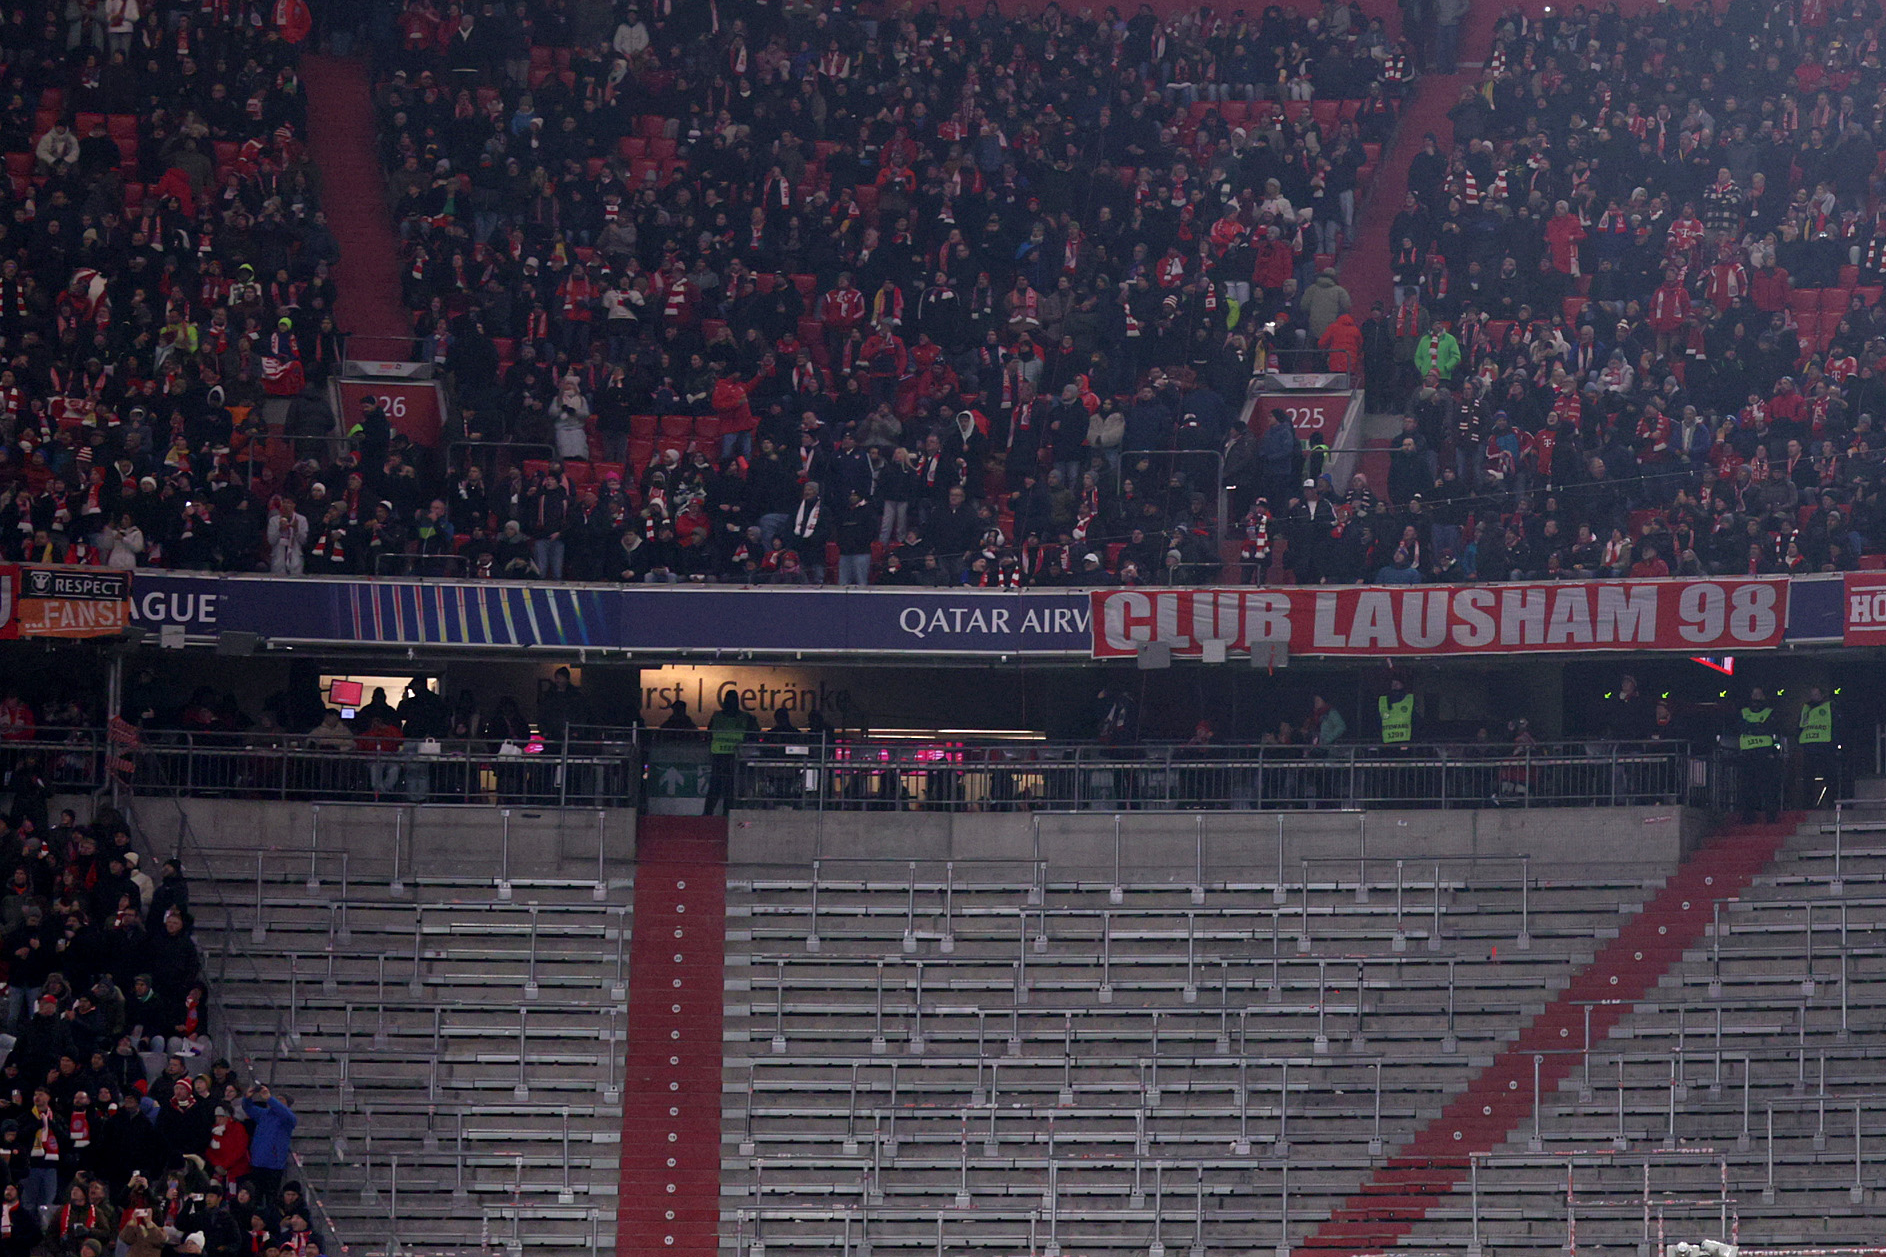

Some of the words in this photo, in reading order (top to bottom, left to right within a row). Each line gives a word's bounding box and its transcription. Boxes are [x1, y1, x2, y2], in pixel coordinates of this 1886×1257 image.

[373, 395, 407, 418] 26
[55, 578, 123, 595] RESPECT
[900, 607, 1011, 639] QATAR
[1103, 591, 1292, 649] CLUB
[1312, 585, 1658, 648] LAUSHAM
[1678, 582, 1778, 642] 98
